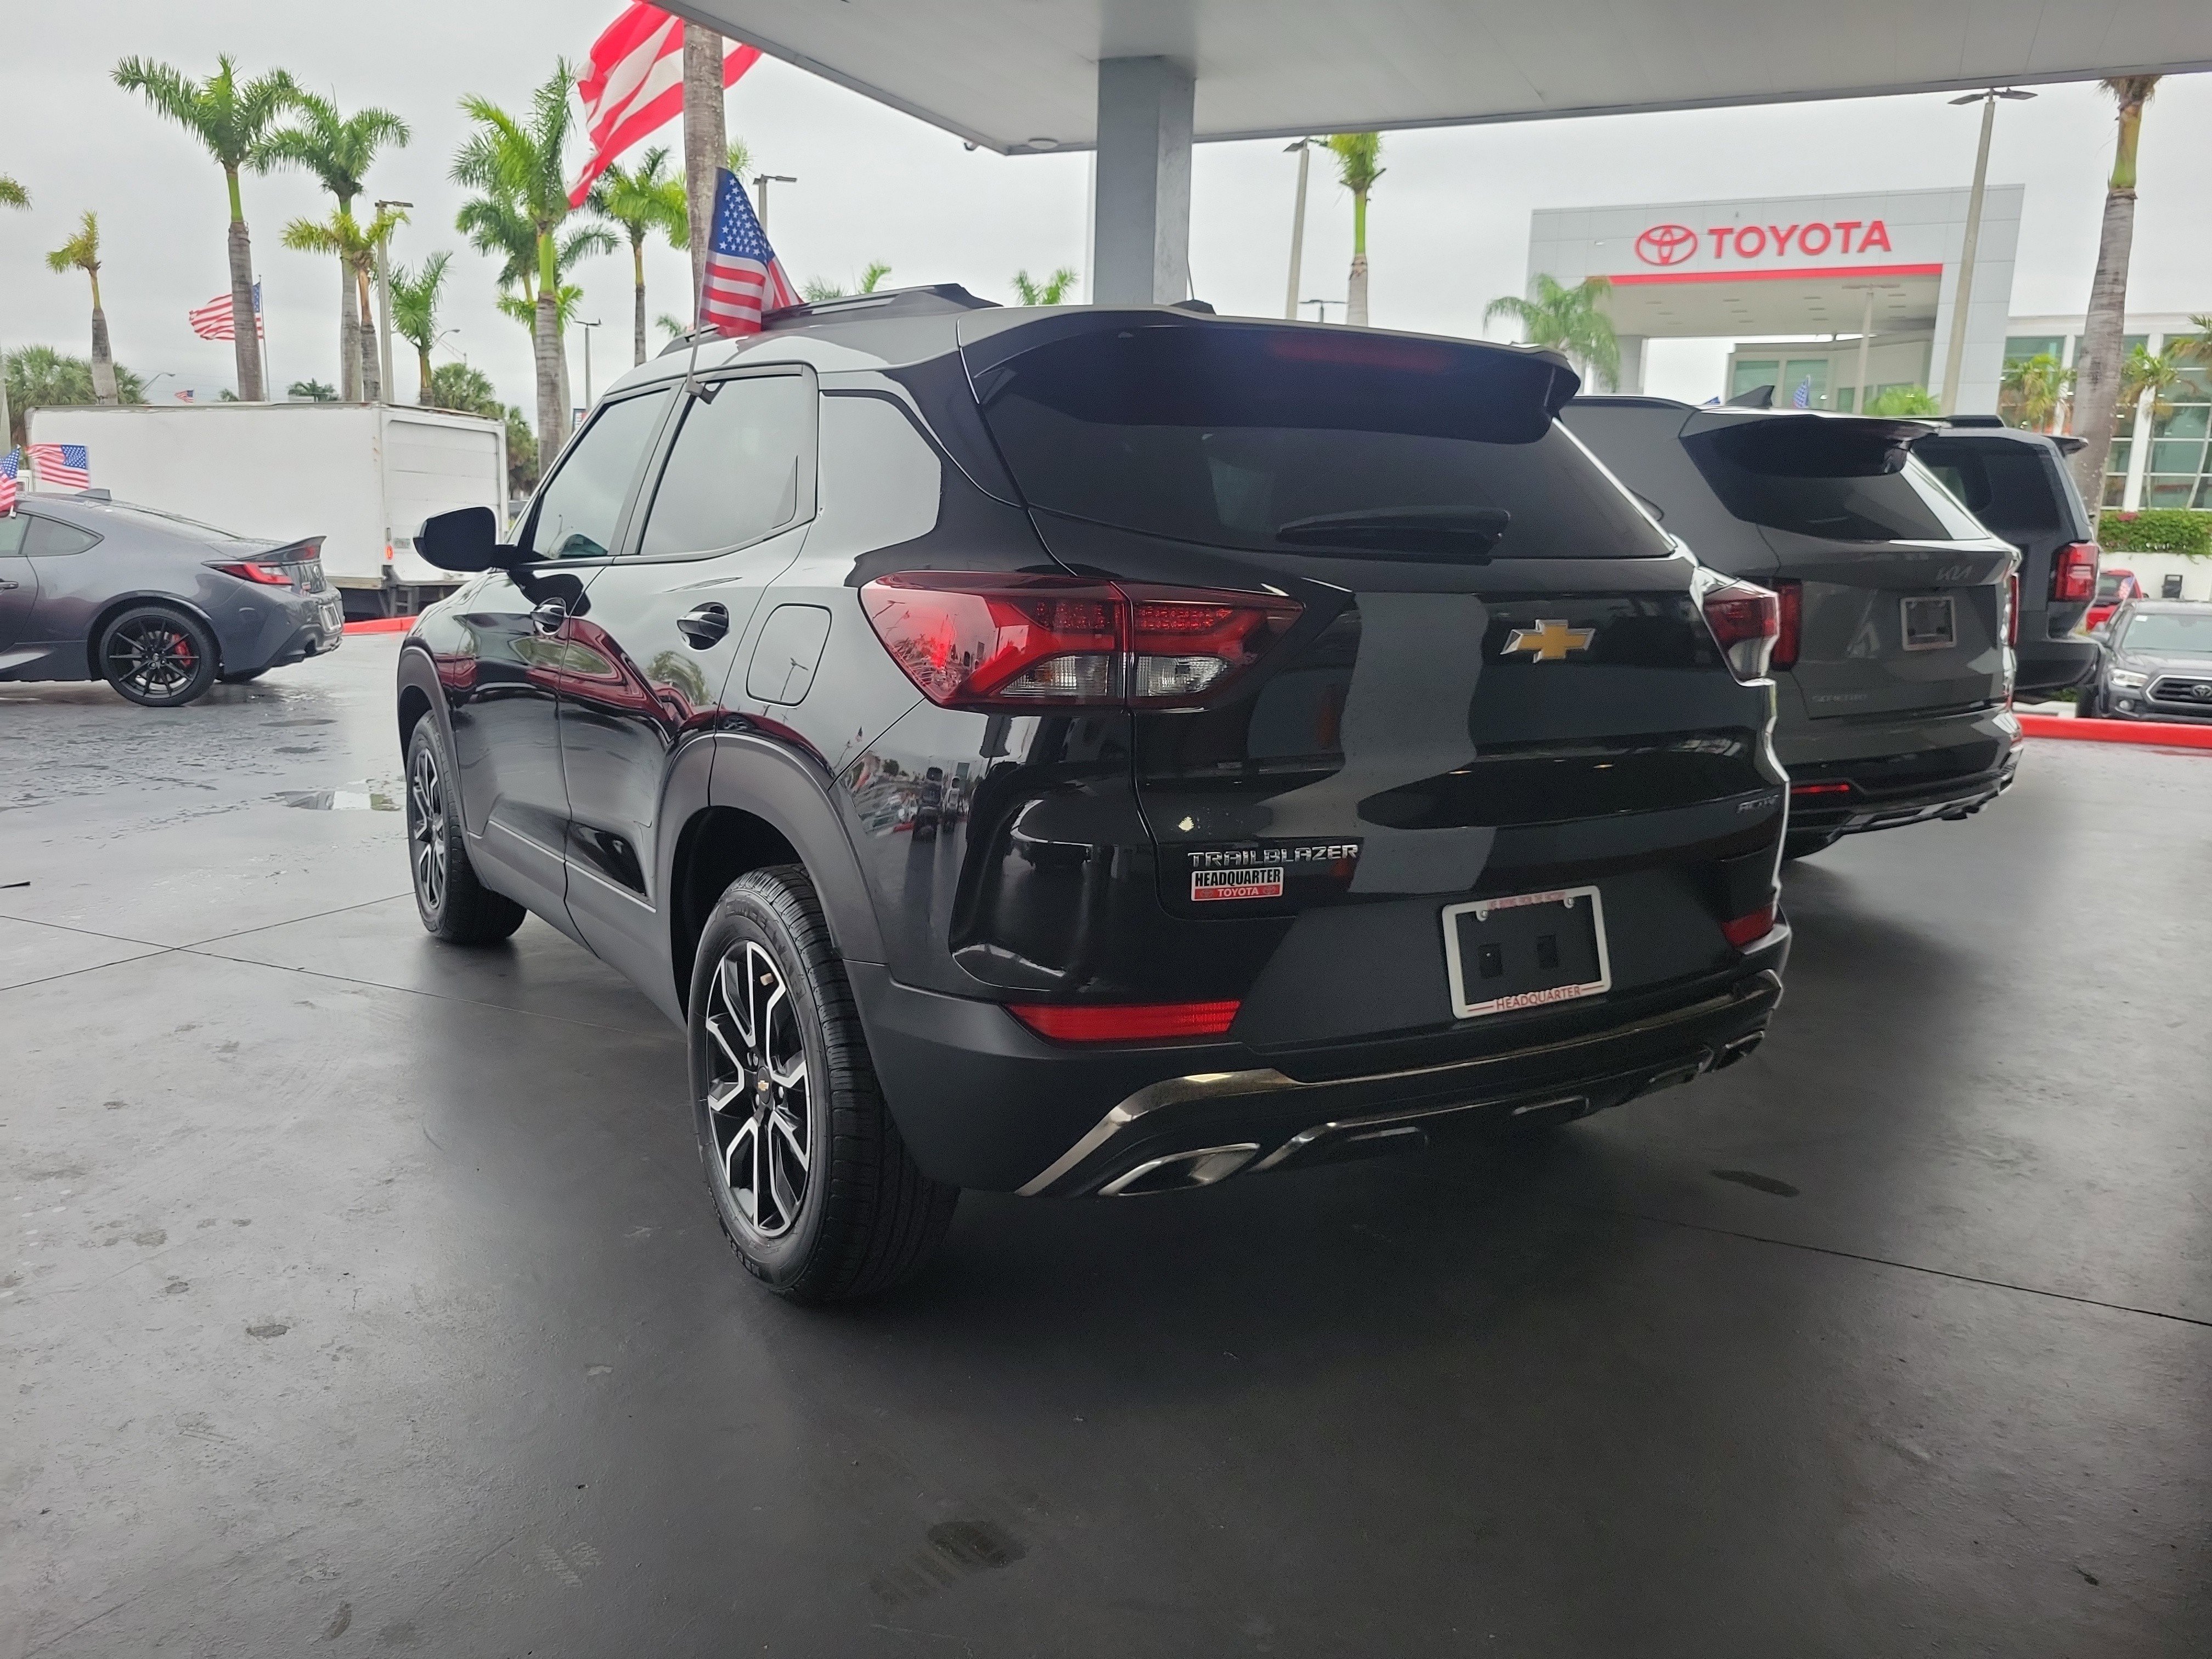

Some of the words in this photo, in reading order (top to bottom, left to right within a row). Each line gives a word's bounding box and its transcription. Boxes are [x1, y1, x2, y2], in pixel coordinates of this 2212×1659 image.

[1708, 221, 1892, 259] TOYOTA
[1187, 844, 1358, 867] TRAILBLAZER
[1195, 868, 1281, 887] HEADQUARTER
[1217, 887, 1259, 898] TOYOTA
[1496, 985, 1581, 1011] HEADQUARTER
